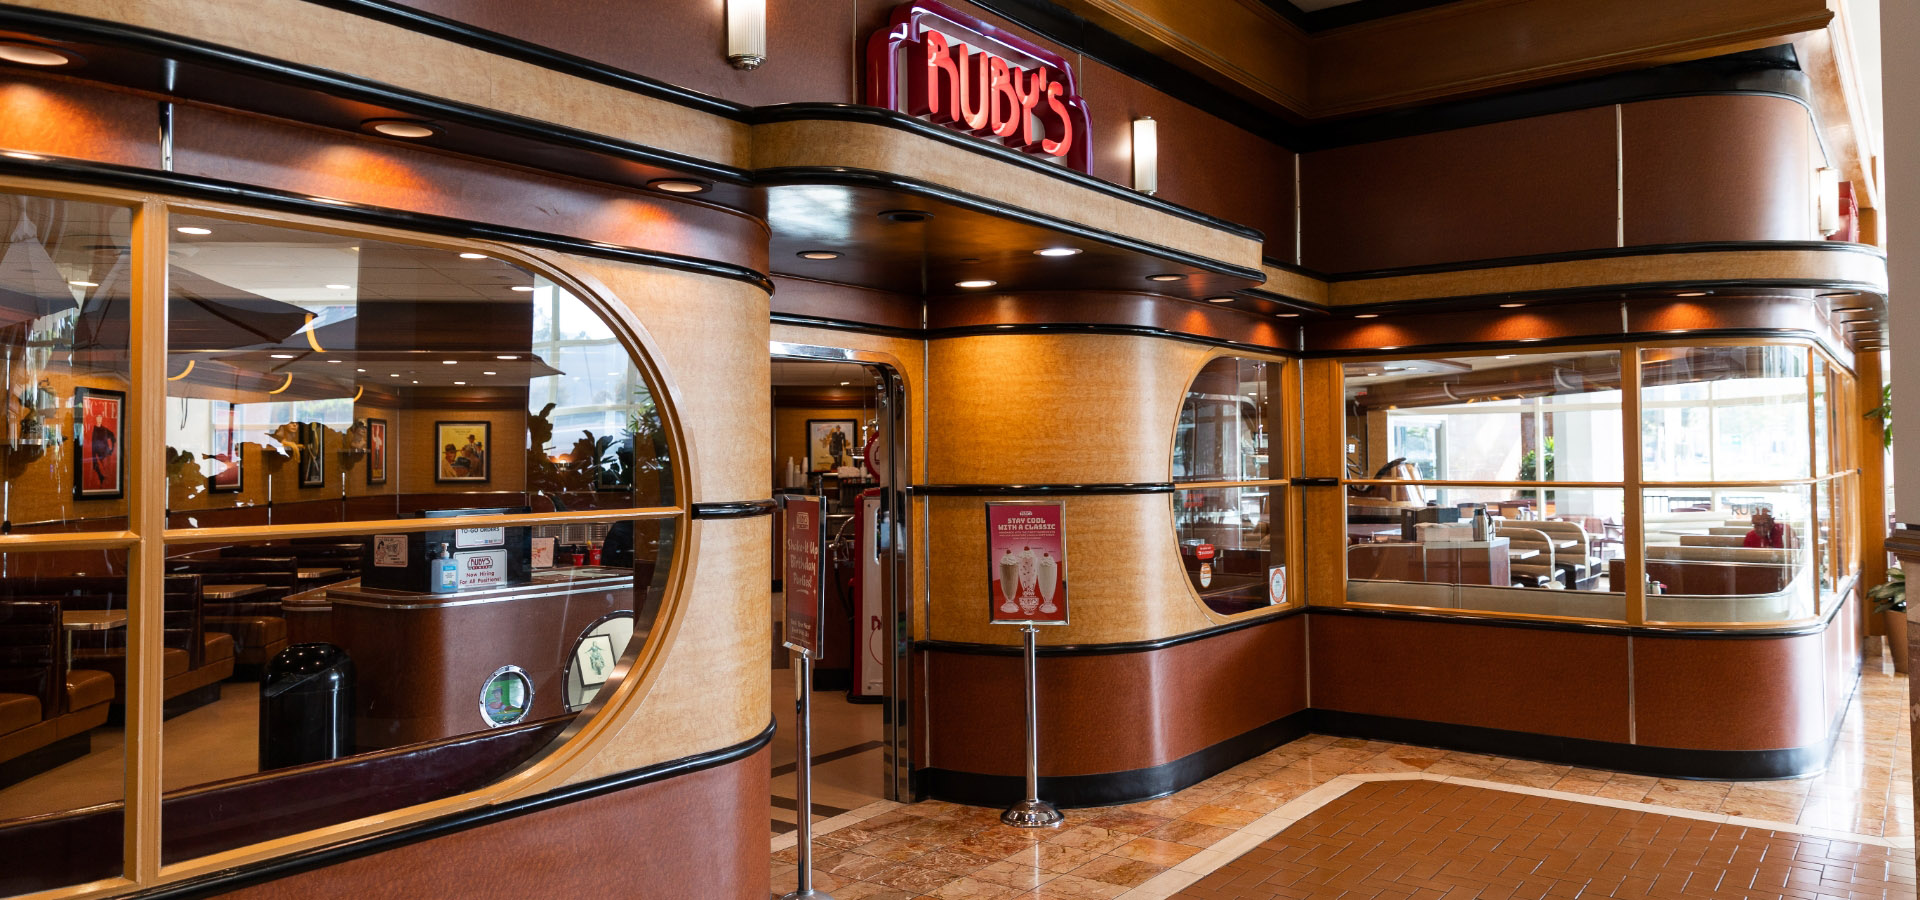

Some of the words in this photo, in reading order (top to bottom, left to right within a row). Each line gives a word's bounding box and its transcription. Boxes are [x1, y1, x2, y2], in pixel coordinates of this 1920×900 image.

[927, 29, 1073, 157] RUBY'S
[470, 557, 491, 566] RUBY'S
[790, 554, 816, 576] Birthday
